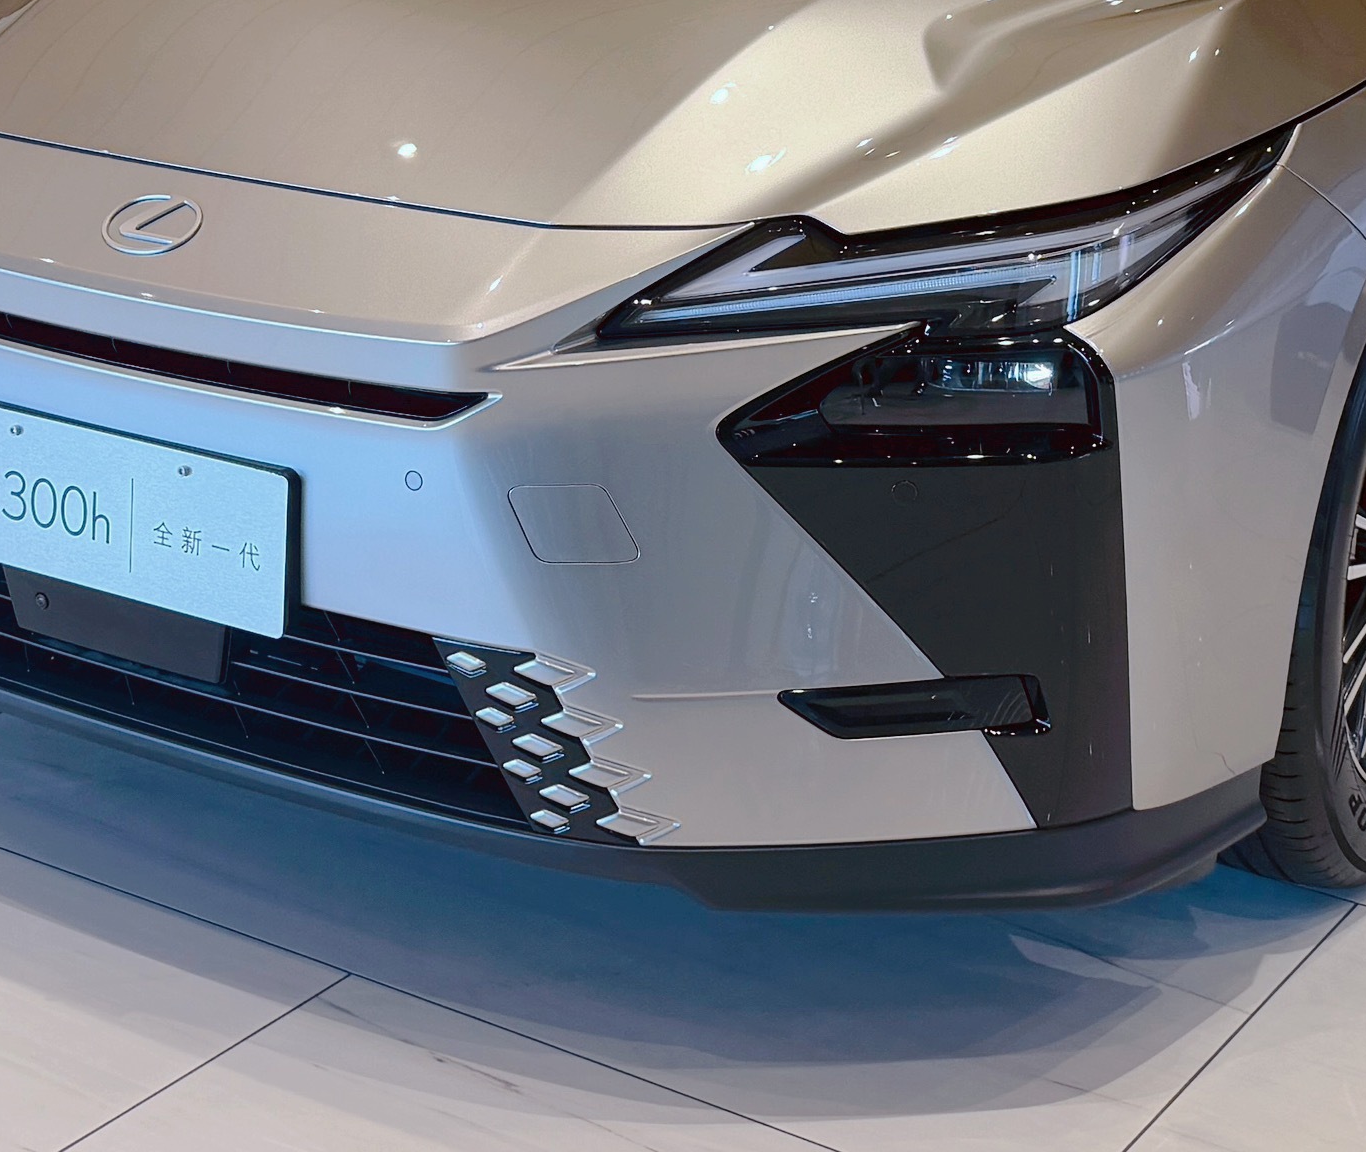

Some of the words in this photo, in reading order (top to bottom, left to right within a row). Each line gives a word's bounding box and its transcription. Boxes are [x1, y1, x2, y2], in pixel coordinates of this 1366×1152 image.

[1, 469, 111, 545] 300h
[152, 521, 262, 573] 全新一代
